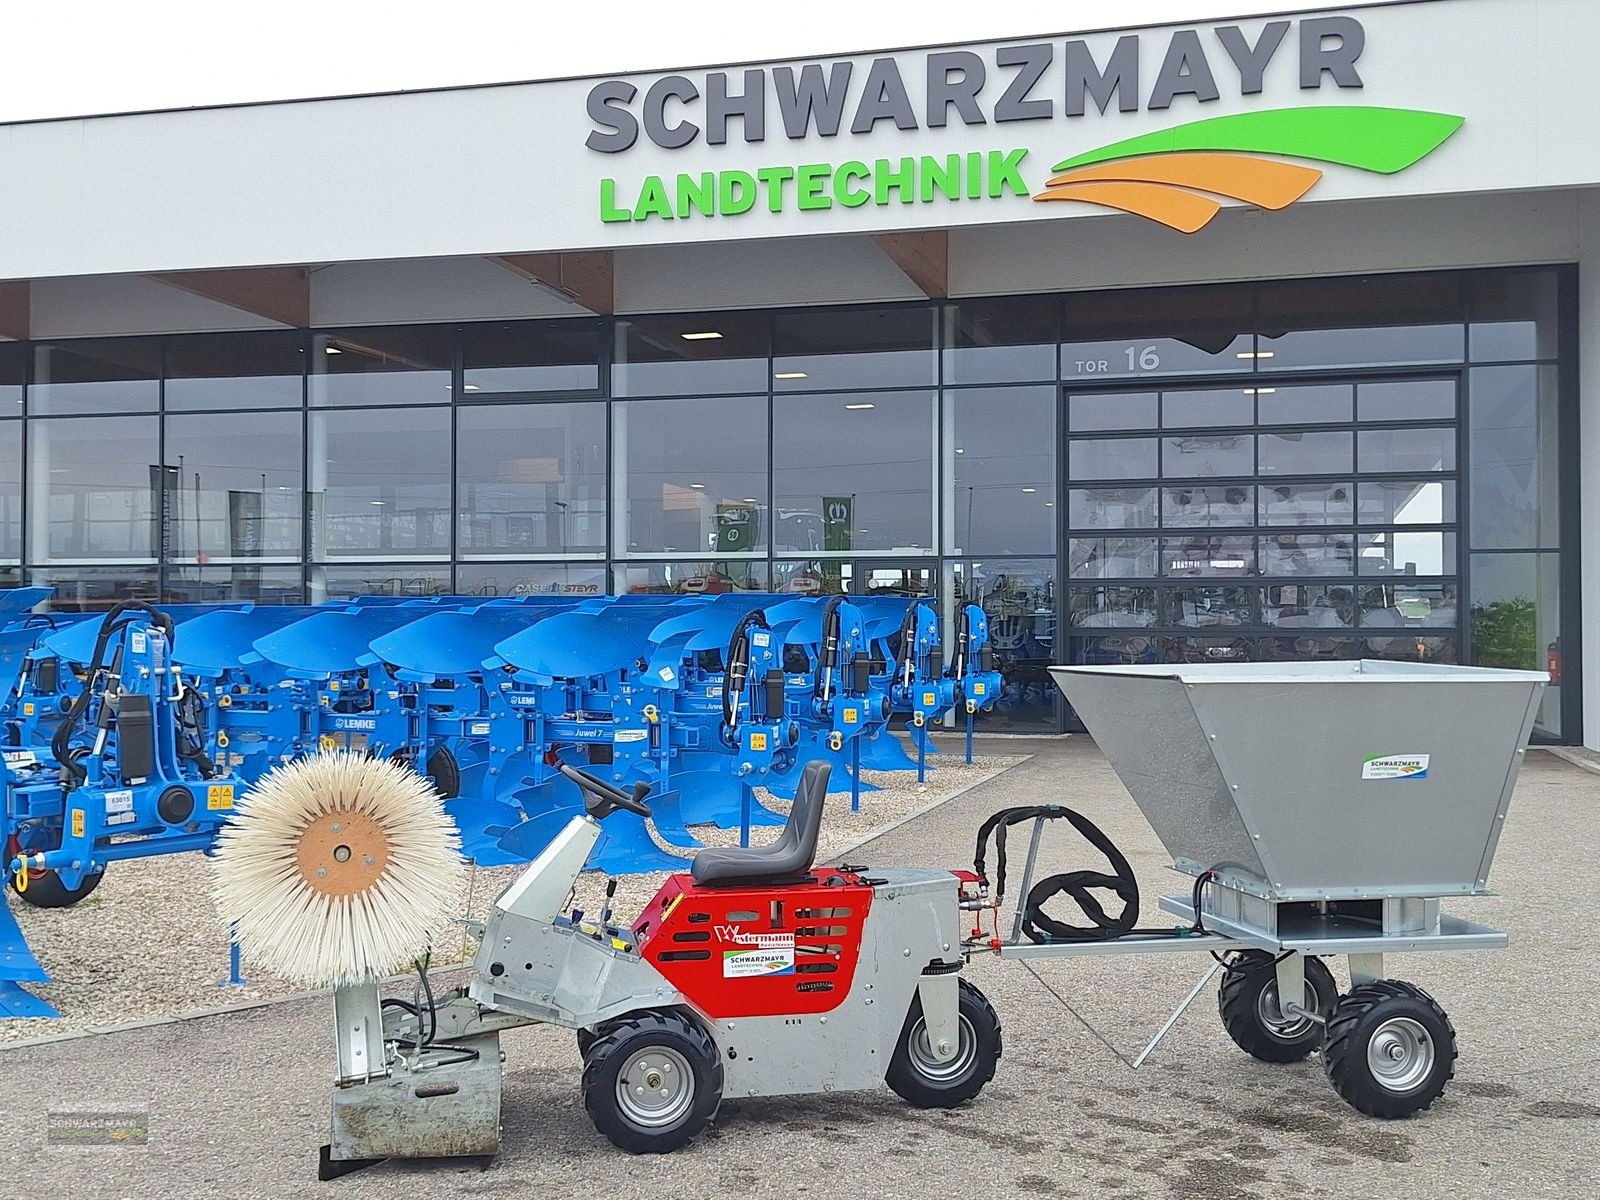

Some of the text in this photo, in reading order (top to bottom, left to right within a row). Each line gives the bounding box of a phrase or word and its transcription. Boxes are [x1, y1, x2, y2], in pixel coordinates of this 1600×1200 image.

[585, 16, 1365, 154] SCHWARZMAYR
[601, 148, 1030, 223] LANDTECHNIK
[1075, 345, 1160, 373] TOR 16
[563, 584, 598, 593] STEYR
[344, 719, 376, 729] LEMKE
[574, 729, 597, 737] Juwel
[713, 924, 794, 943] Westermann
[730, 955, 785, 964] SCHWARZMAYR
